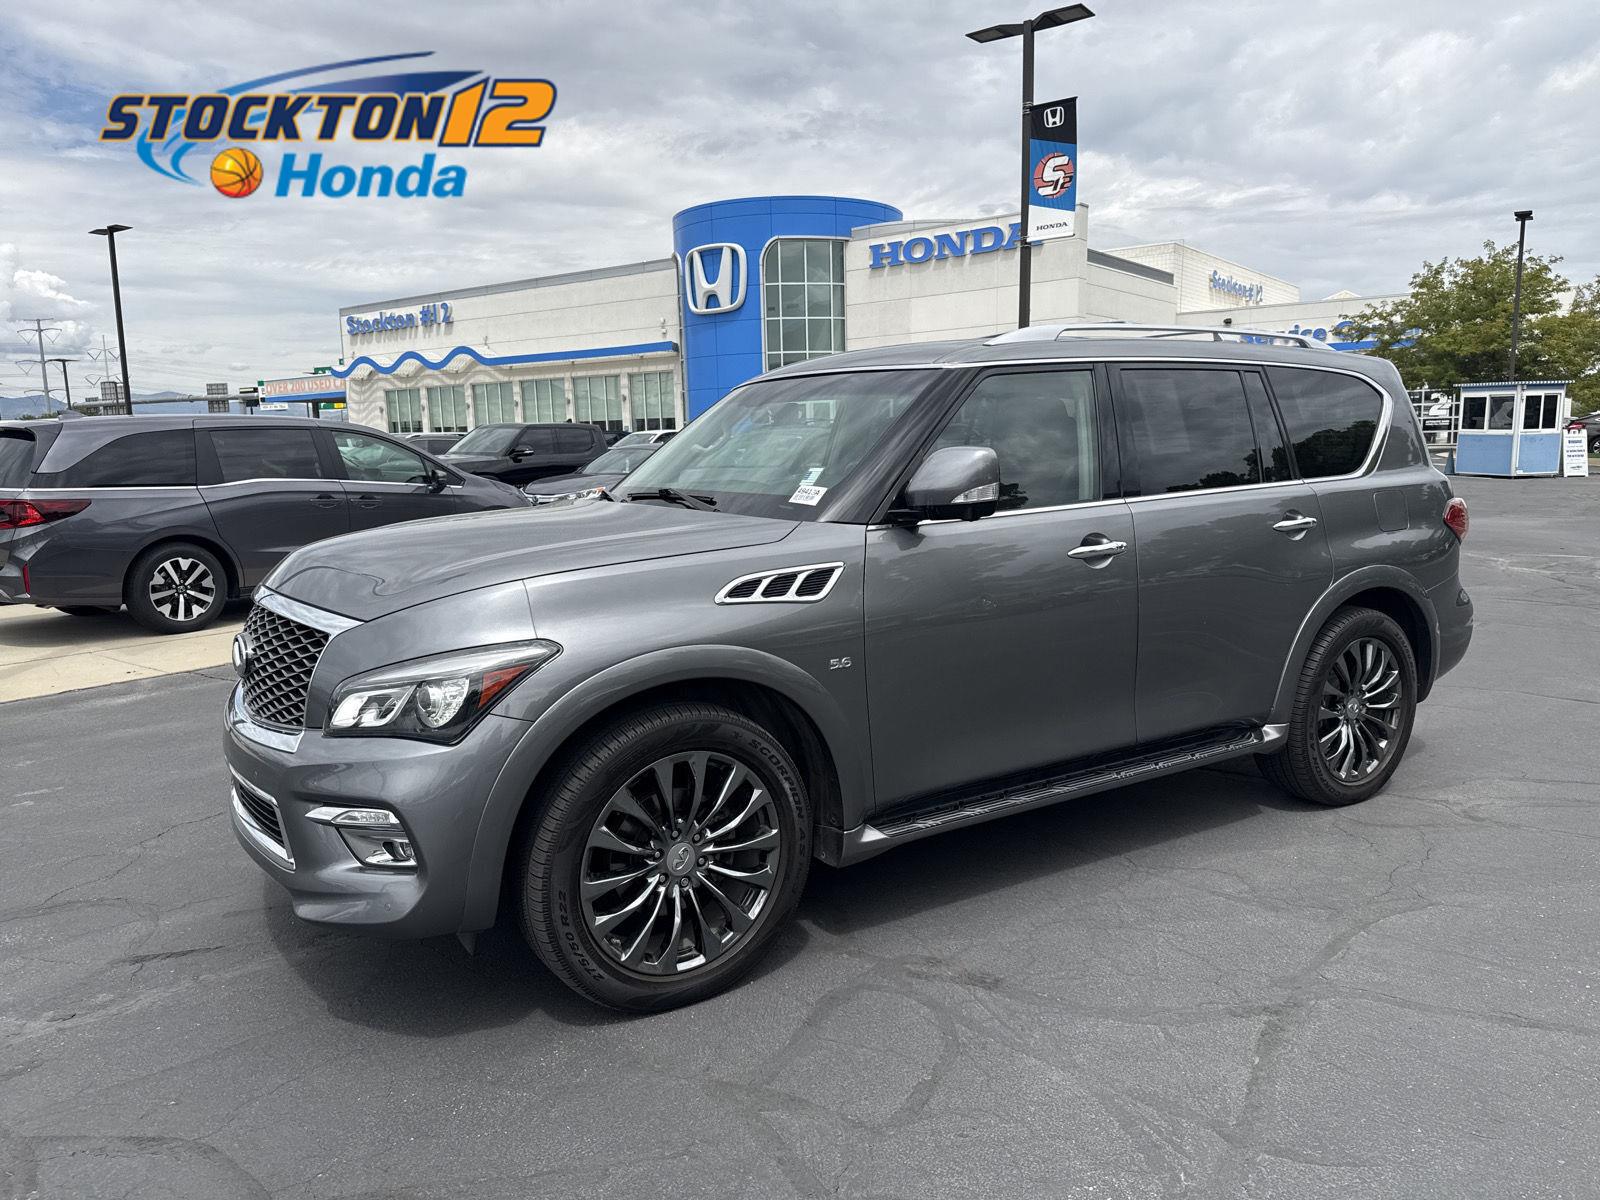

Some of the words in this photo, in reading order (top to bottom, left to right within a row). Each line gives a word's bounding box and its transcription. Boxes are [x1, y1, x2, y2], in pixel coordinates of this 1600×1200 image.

[1036, 221, 1069, 231] HONDA
[346, 312, 416, 336] Stockton
[265, 382, 289, 396] OVER
[290, 380, 306, 393] 200
[307, 377, 332, 392] USED
[830, 656, 852, 670] 5.6
[748, 738, 805, 819] SCORPION
[558, 889, 570, 927] R22
[565, 932, 606, 982] 275/50
